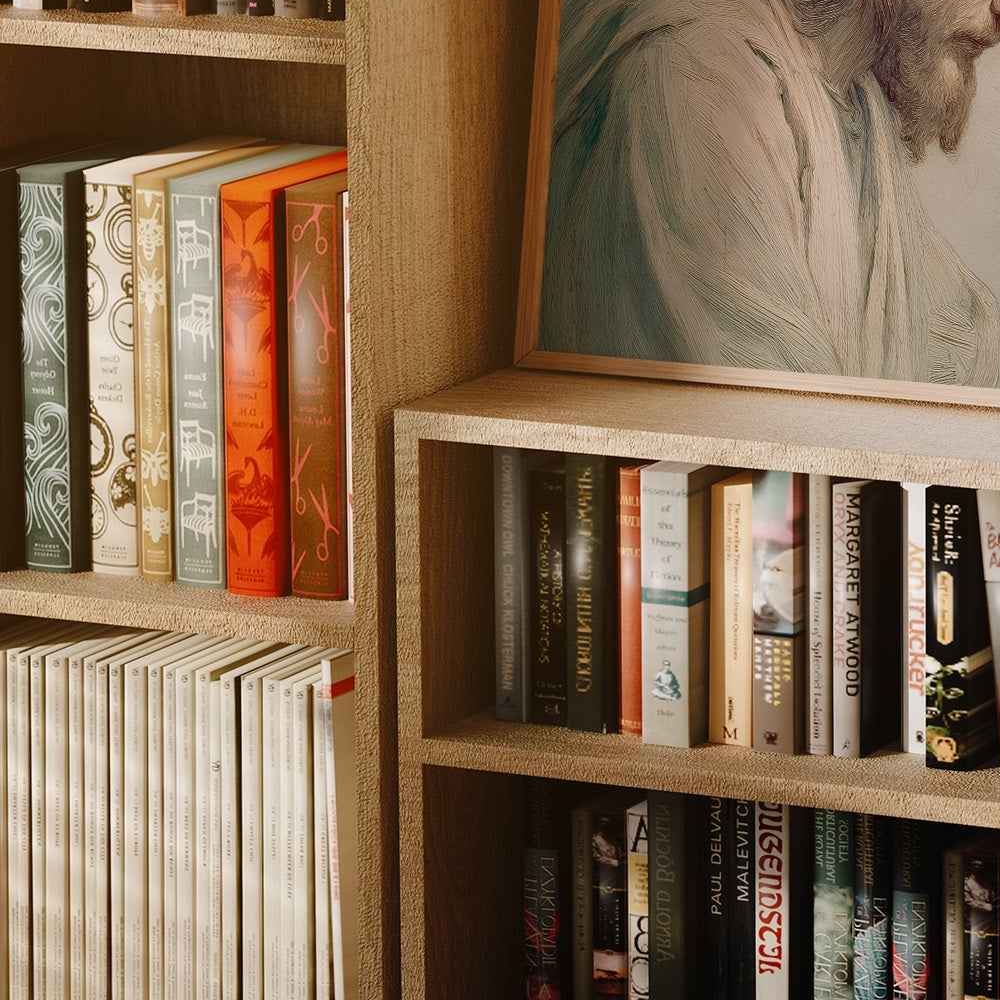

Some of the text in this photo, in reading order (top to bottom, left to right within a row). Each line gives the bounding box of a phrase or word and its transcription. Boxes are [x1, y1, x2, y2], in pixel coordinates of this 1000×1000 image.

[501, 454, 514, 691] DOWNTOWN OWL CHUCK KLOSTERMAN
[651, 537, 682, 550] Theory
[833, 491, 846, 670] ORYX AND CRAKE
[845, 492, 859, 698] MARGARET ATWOOD
[710, 797, 722, 916] PAUL DELVAU
